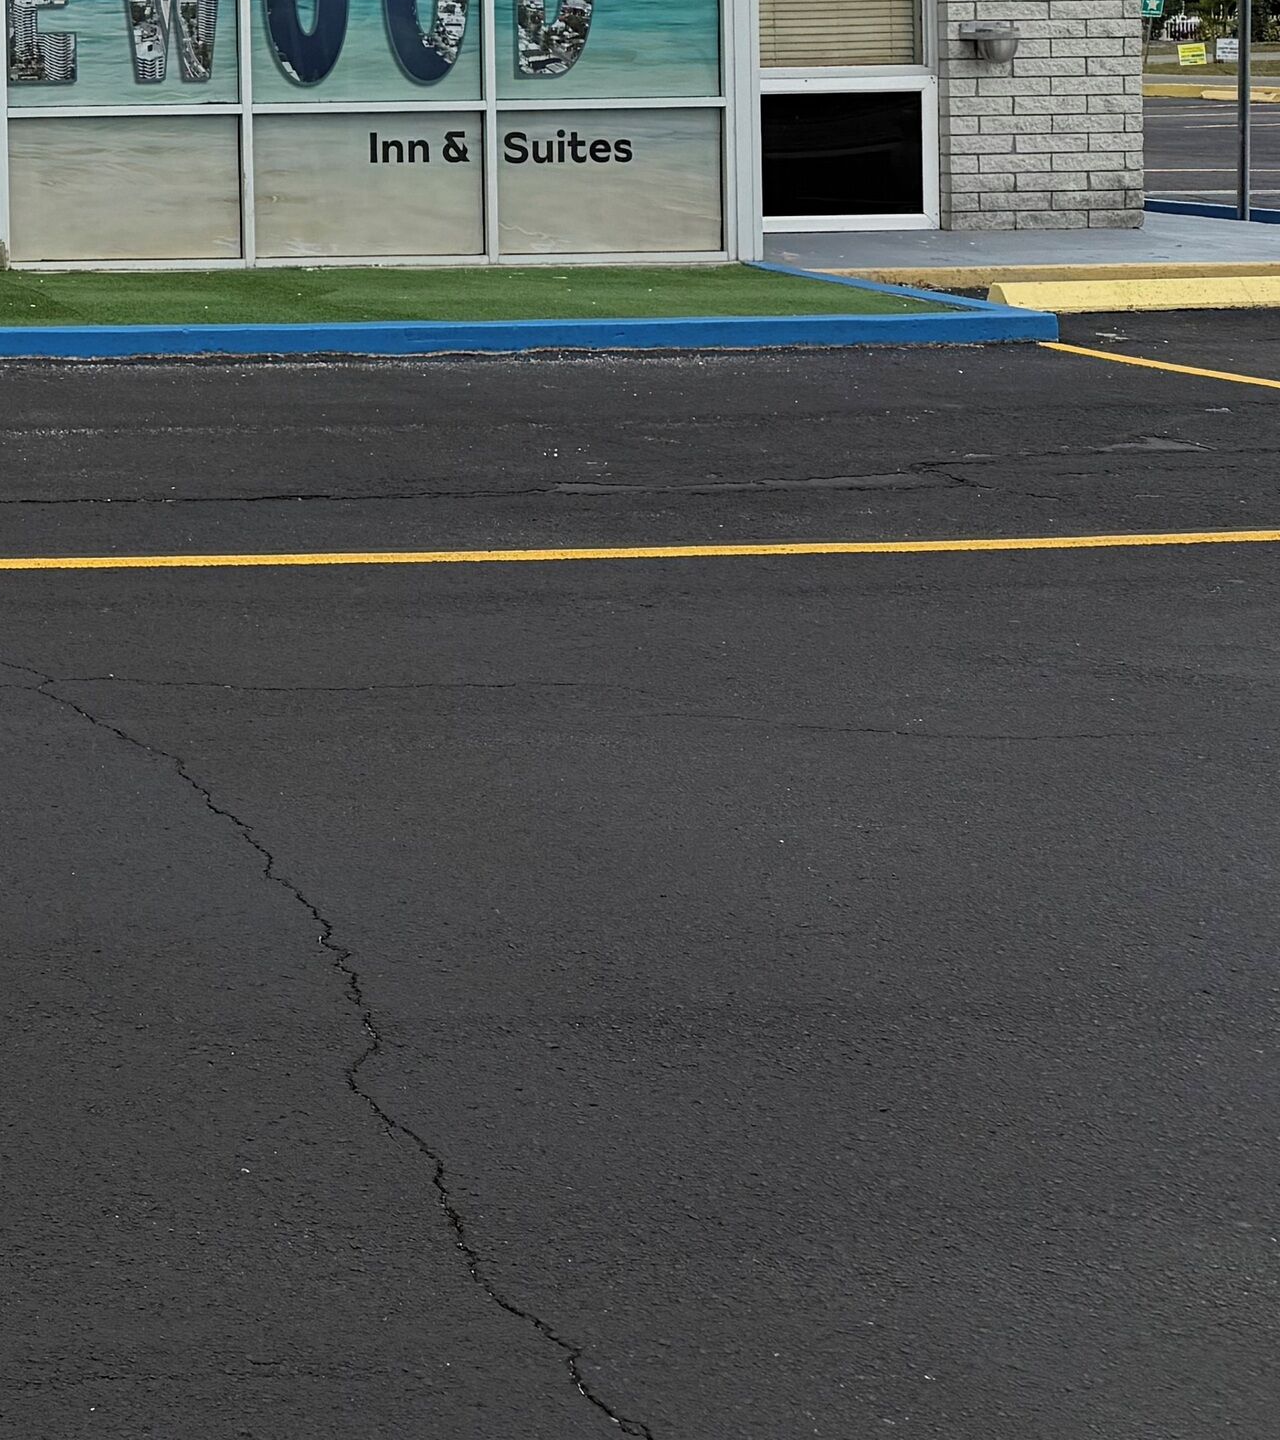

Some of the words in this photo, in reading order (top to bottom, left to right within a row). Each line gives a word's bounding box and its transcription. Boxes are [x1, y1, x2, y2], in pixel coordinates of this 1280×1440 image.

[369, 132, 430, 164] Inn
[442, 131, 470, 162] &
[503, 129, 633, 164] Suites
